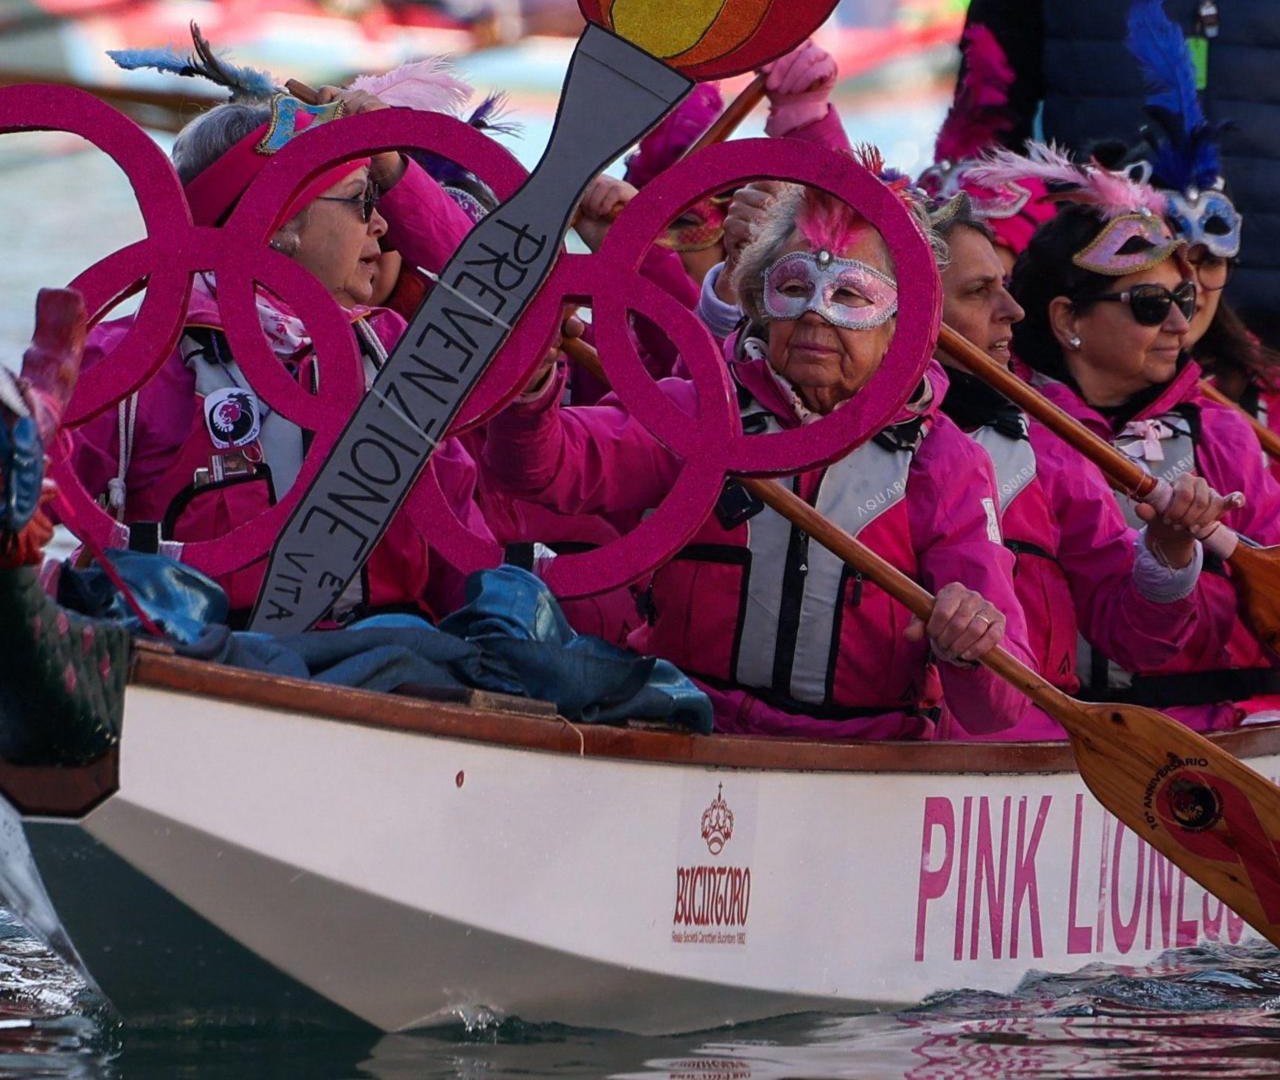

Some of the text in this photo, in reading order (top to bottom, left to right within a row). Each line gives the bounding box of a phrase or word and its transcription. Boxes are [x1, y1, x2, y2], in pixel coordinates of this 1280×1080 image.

[297, 218, 548, 563] PREVENZIONE
[265, 552, 315, 620] VITA
[672, 865, 751, 927] BUCINTORO
[913, 794, 1053, 963] PINK
